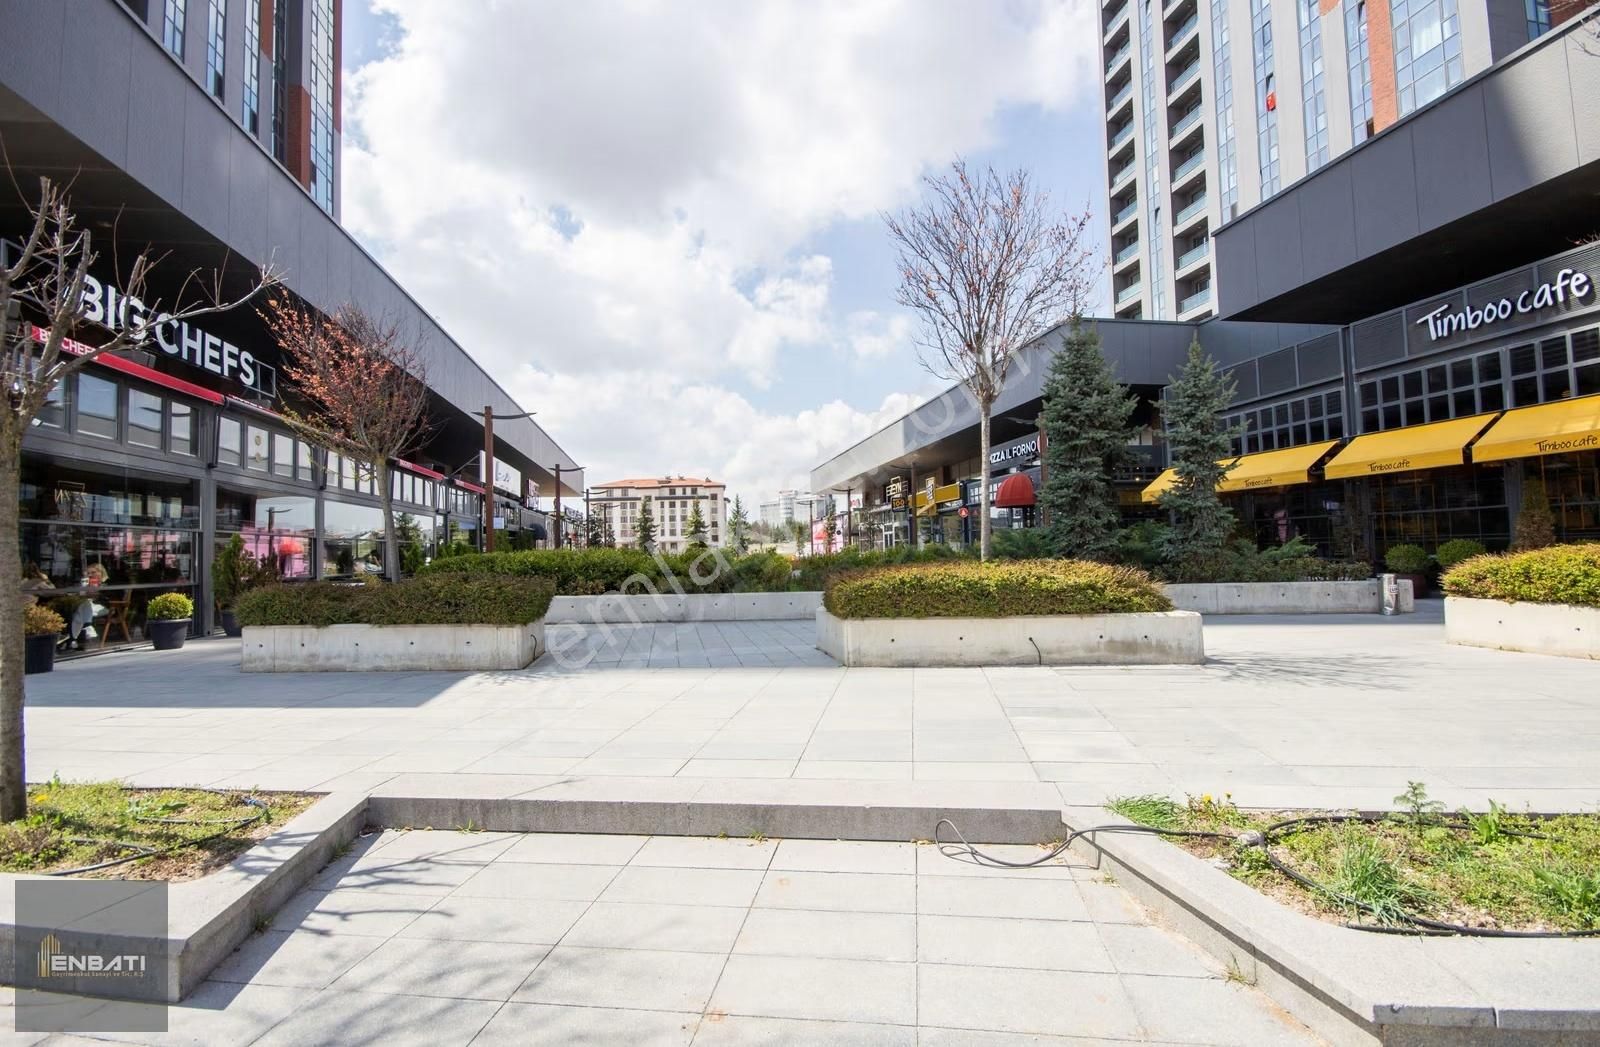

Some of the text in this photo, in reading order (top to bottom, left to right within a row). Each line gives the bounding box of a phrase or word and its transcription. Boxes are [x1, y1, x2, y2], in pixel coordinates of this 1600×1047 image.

[1416, 269, 1590, 341] Timboo cafe
[76, 273, 255, 386] BIG CHEFS
[989, 450, 1005, 464] IZZA
[1012, 440, 1037, 458] FORNO
[1534, 434, 1598, 453] Timboo cafe
[1368, 460, 1411, 473] Timboo cafe
